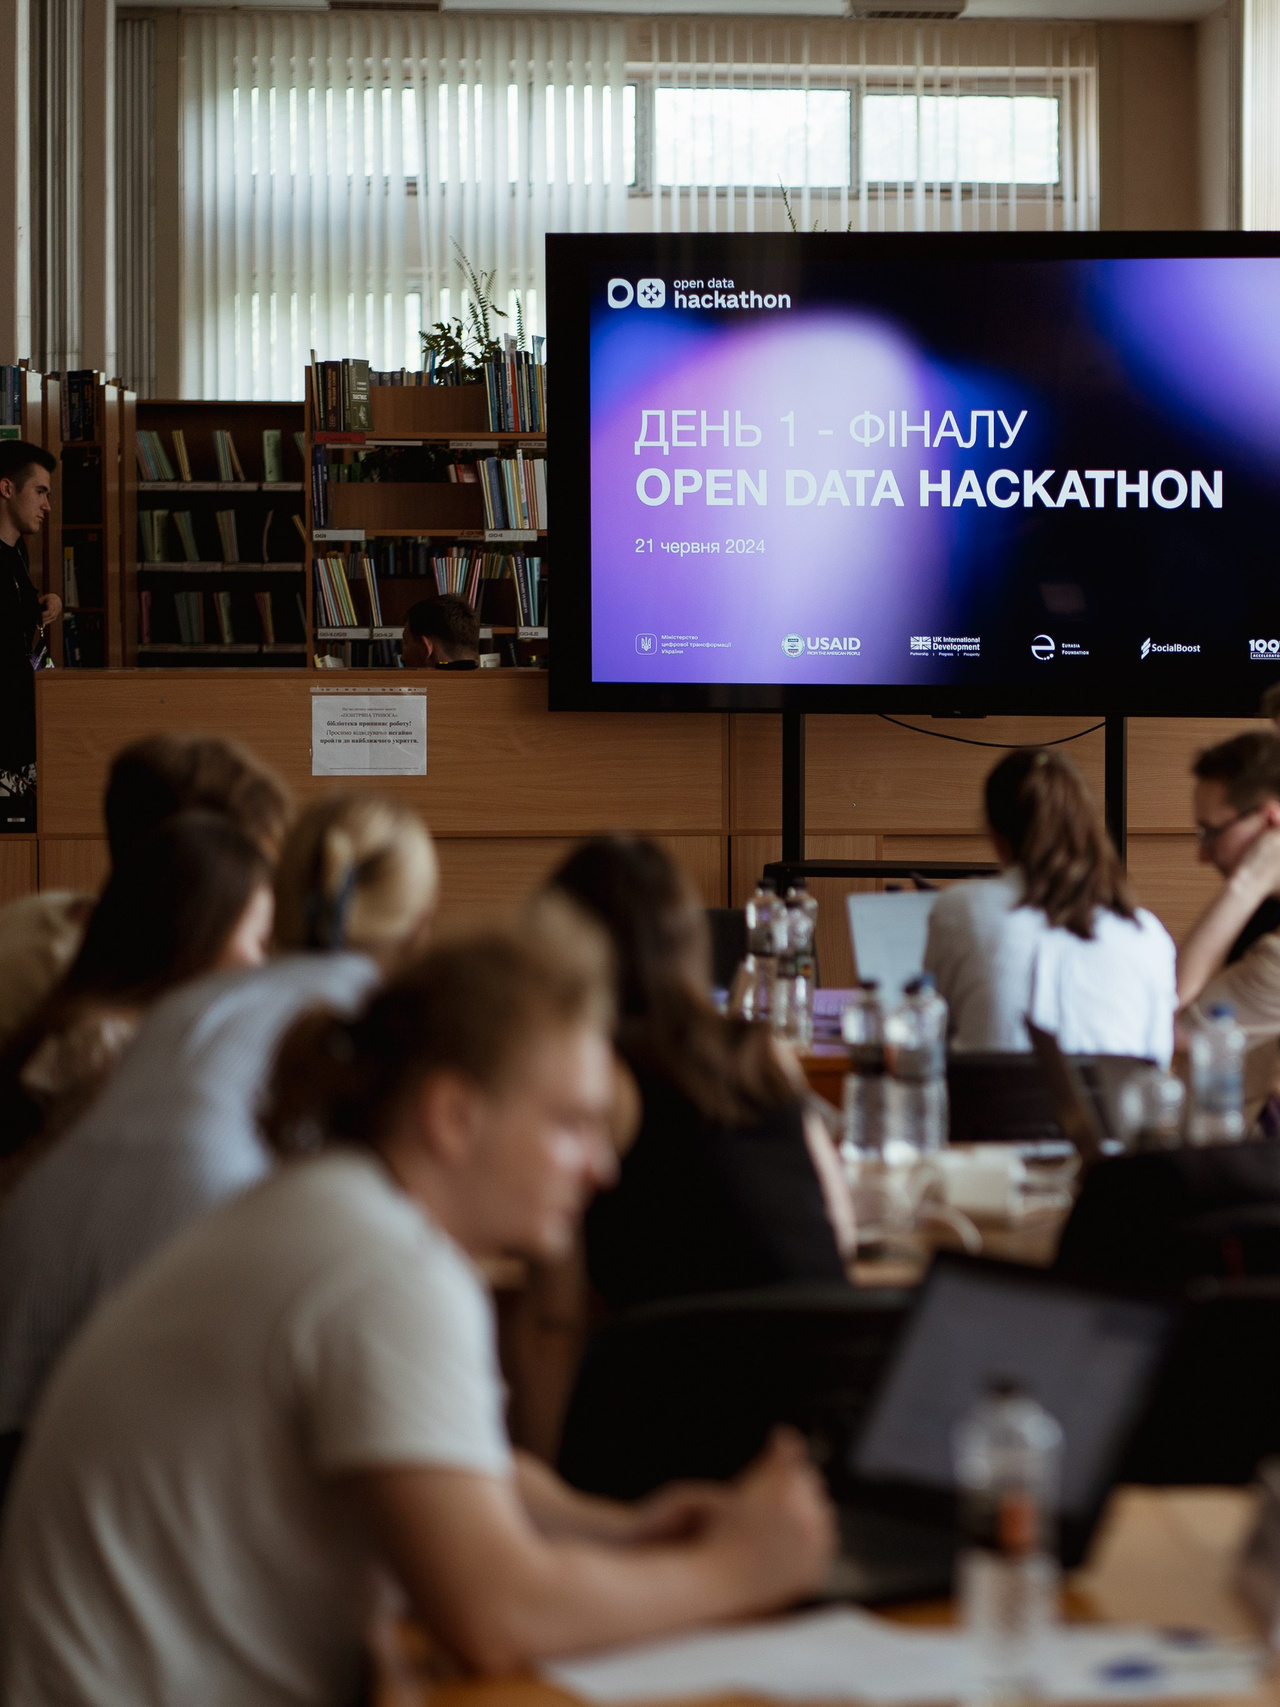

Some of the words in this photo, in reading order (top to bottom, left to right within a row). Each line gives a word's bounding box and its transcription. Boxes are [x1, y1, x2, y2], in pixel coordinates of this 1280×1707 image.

[674, 279, 704, 290] open
[707, 278, 735, 289] data
[674, 290, 791, 309] hackathon
[634, 410, 762, 456] ДЕНЬ
[780, 410, 796, 447] 1
[849, 409, 1028, 449] ФІНАЛУ
[635, 467, 767, 507] OPEN
[785, 468, 905, 508] DATA
[919, 468, 1223, 509] HACKATHON
[634, 538, 654, 553] 21
[660, 541, 721, 556] червня
[725, 538, 766, 554] 2024
[807, 637, 861, 651] USAID
[933, 643, 981, 652] Development
[1151, 643, 1201, 652] SocialBoost
[389, 720, 412, 728] роботу!
